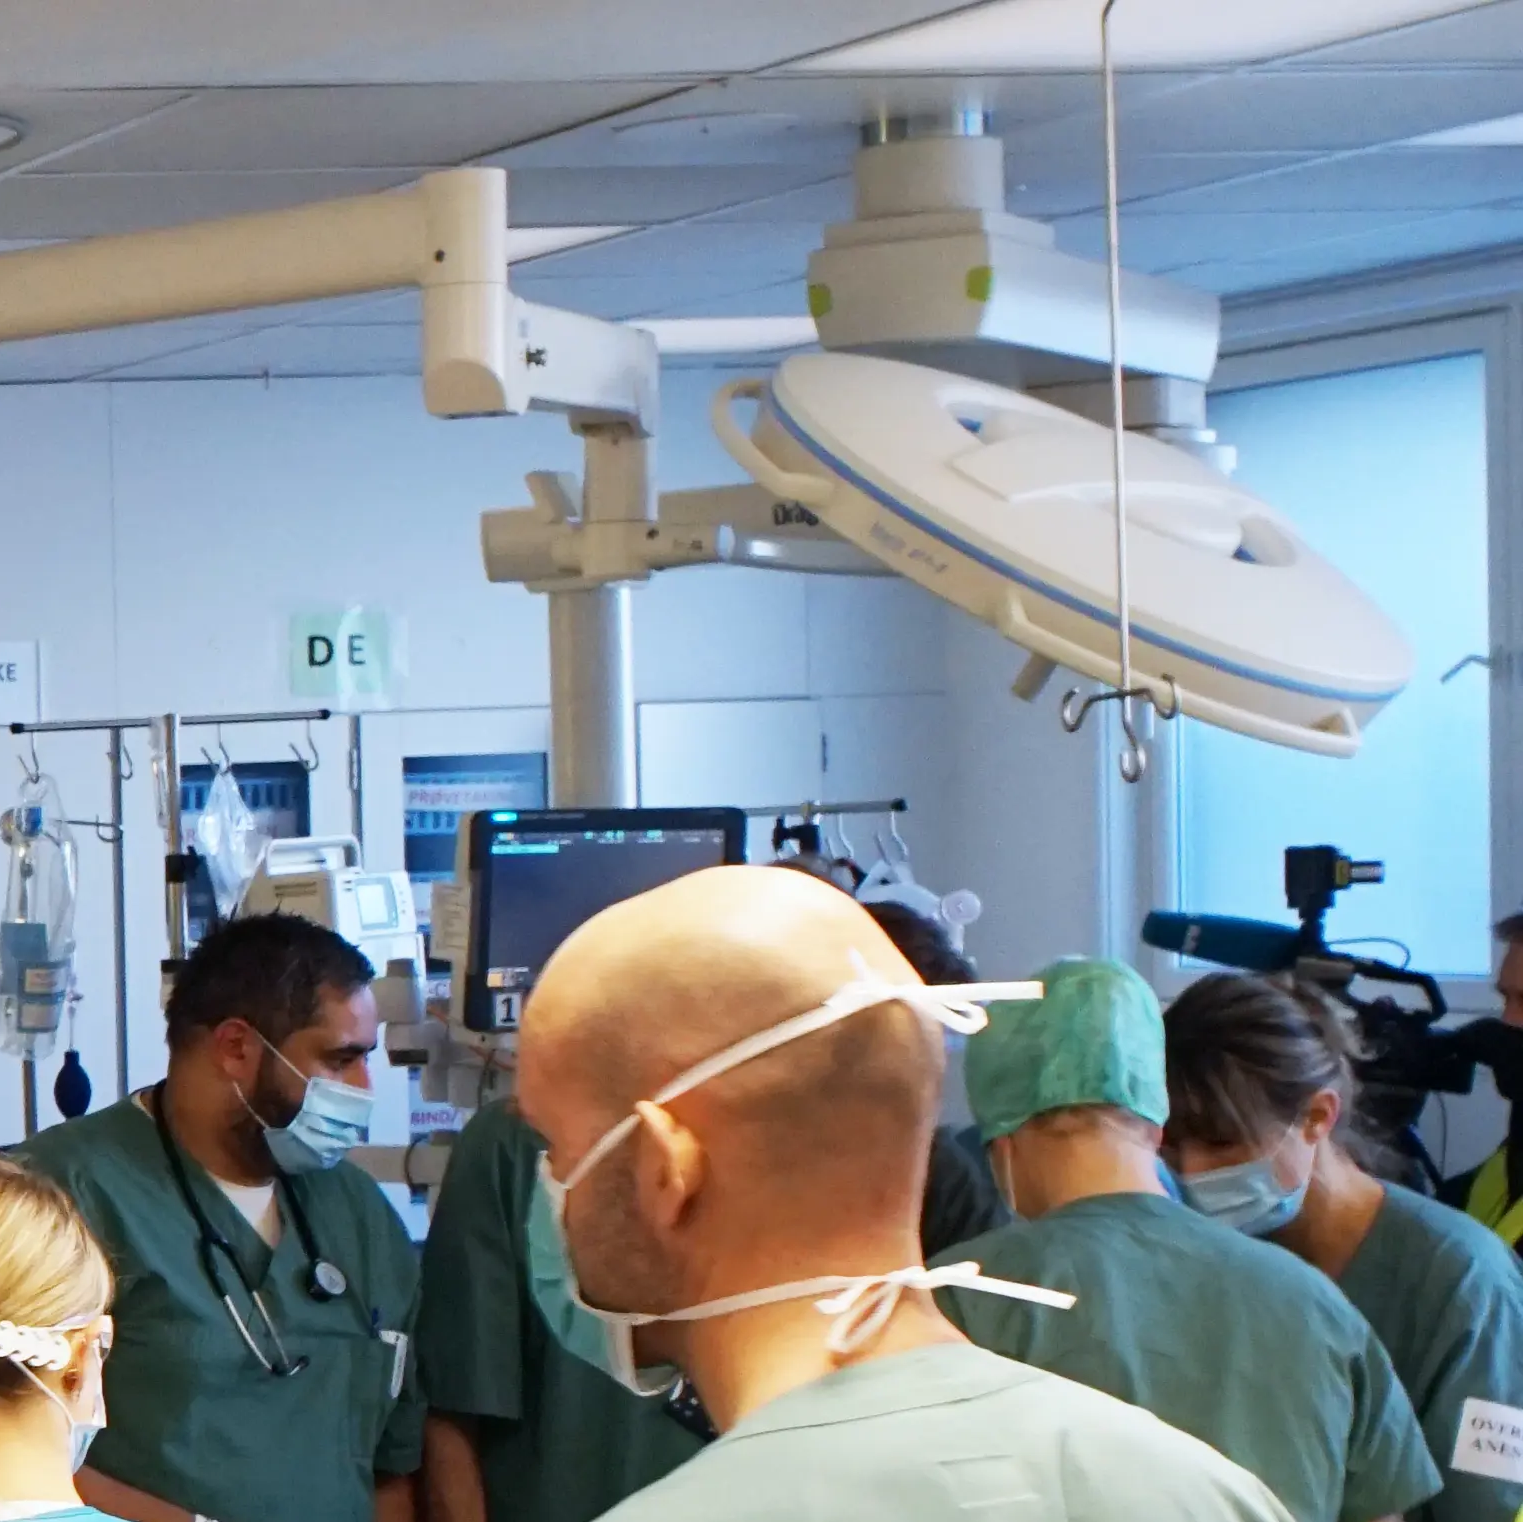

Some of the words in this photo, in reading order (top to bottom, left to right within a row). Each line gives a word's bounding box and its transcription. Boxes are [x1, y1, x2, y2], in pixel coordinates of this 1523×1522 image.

[308, 636, 334, 667] D
[349, 635, 366, 664] E
[500, 996, 516, 1023] 1
